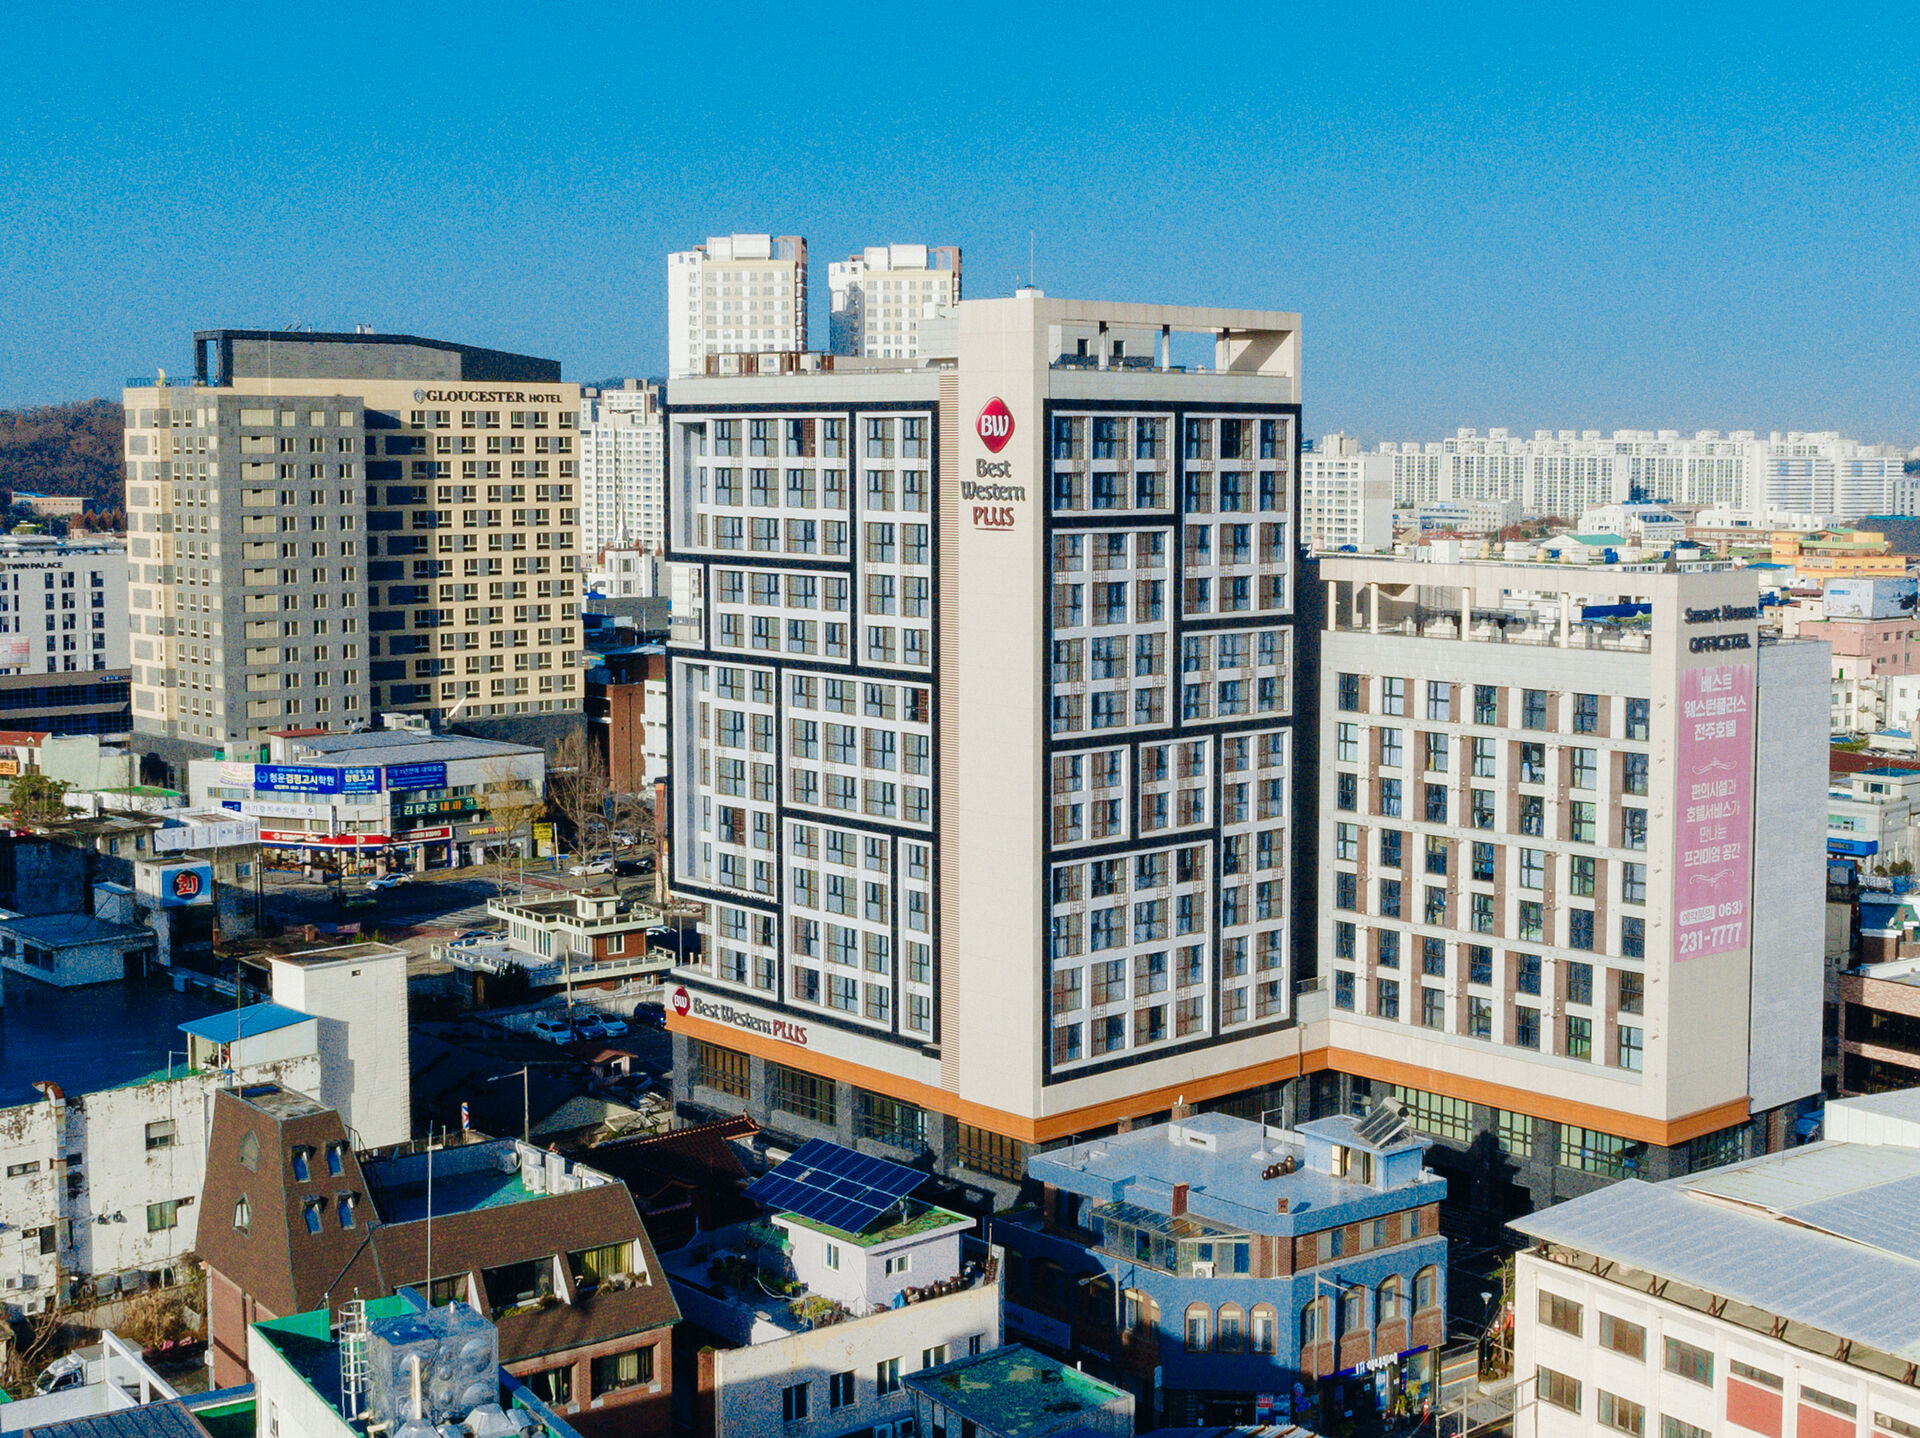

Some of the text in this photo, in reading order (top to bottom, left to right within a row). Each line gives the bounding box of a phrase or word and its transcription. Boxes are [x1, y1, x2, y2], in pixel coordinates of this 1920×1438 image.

[426, 390, 563, 403] GLOUCESTER HOTEL
[981, 414, 1009, 437] BW
[976, 458, 1012, 478] Best
[960, 481, 1026, 501] Western
[973, 506, 1015, 527] PLUS
[1701, 673, 1732, 693] 베스트
[1684, 696, 1747, 718] 웨스턴플러스
[1694, 720, 1737, 741] 전주호텔
[1691, 779, 1736, 801] 편의시설과
[1686, 801, 1740, 823] 호텔서비스가
[1700, 824, 1727, 843] 만나는
[1684, 843, 1741, 867] 프리미엄 공간
[176, 873, 199, 896] 회
[1718, 900, 1743, 918] 063)
[1680, 922, 1743, 954] 231-7777
[674, 994, 688, 1009] BW
[692, 997, 808, 1045] Best Western PLUS
